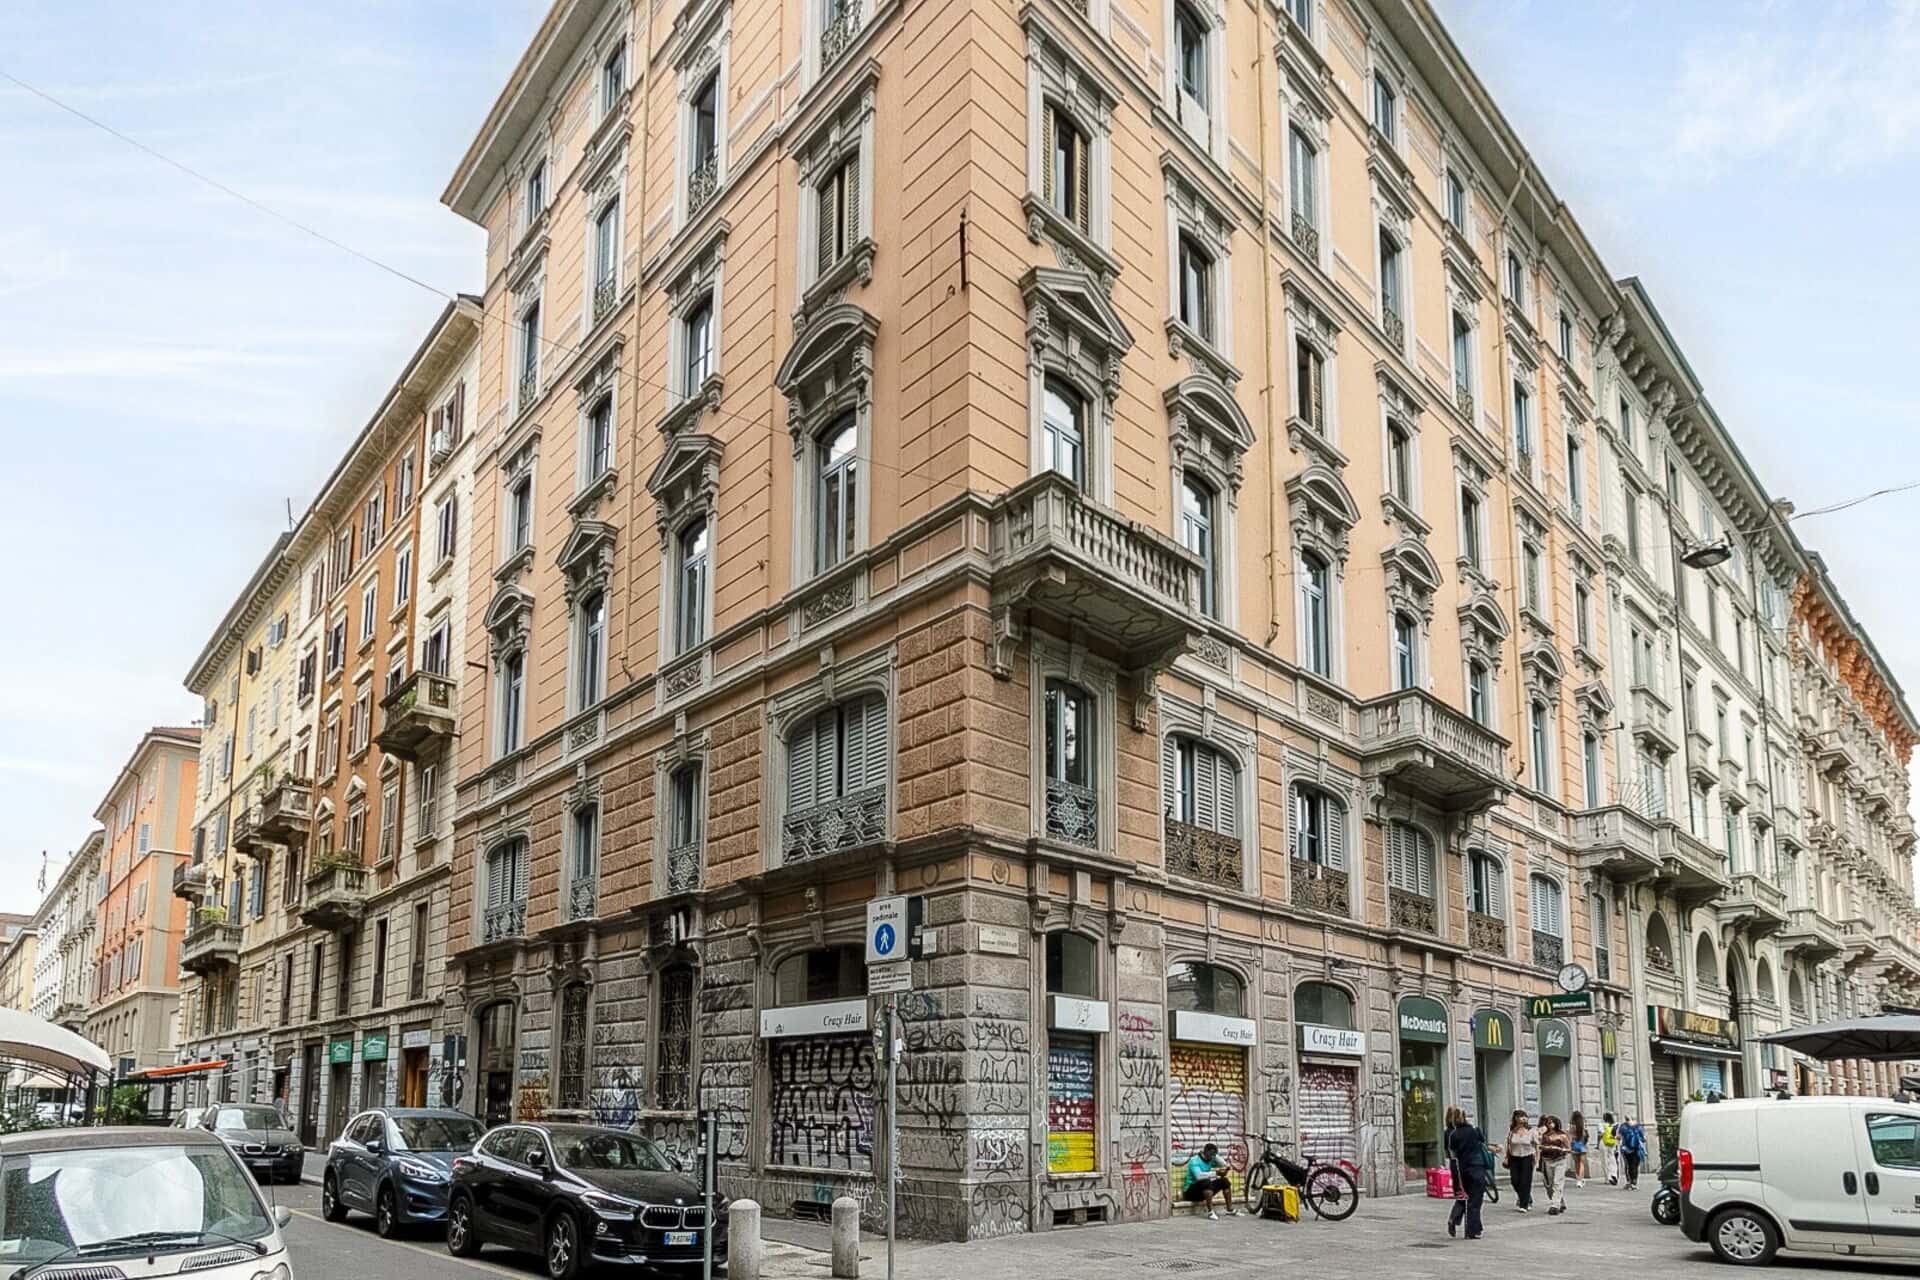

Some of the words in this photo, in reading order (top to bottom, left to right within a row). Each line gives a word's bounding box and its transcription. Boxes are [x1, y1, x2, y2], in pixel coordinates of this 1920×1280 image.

[823, 1015, 842, 1027] Crazy
[844, 1013, 862, 1025] Hair
[1400, 1014, 1447, 1034] McDonald's
[1222, 1027, 1238, 1039] Crazy
[1239, 1029, 1254, 1039] Hair
[1312, 1029, 1336, 1048] Crazy
[1338, 1032, 1358, 1047] Hair
